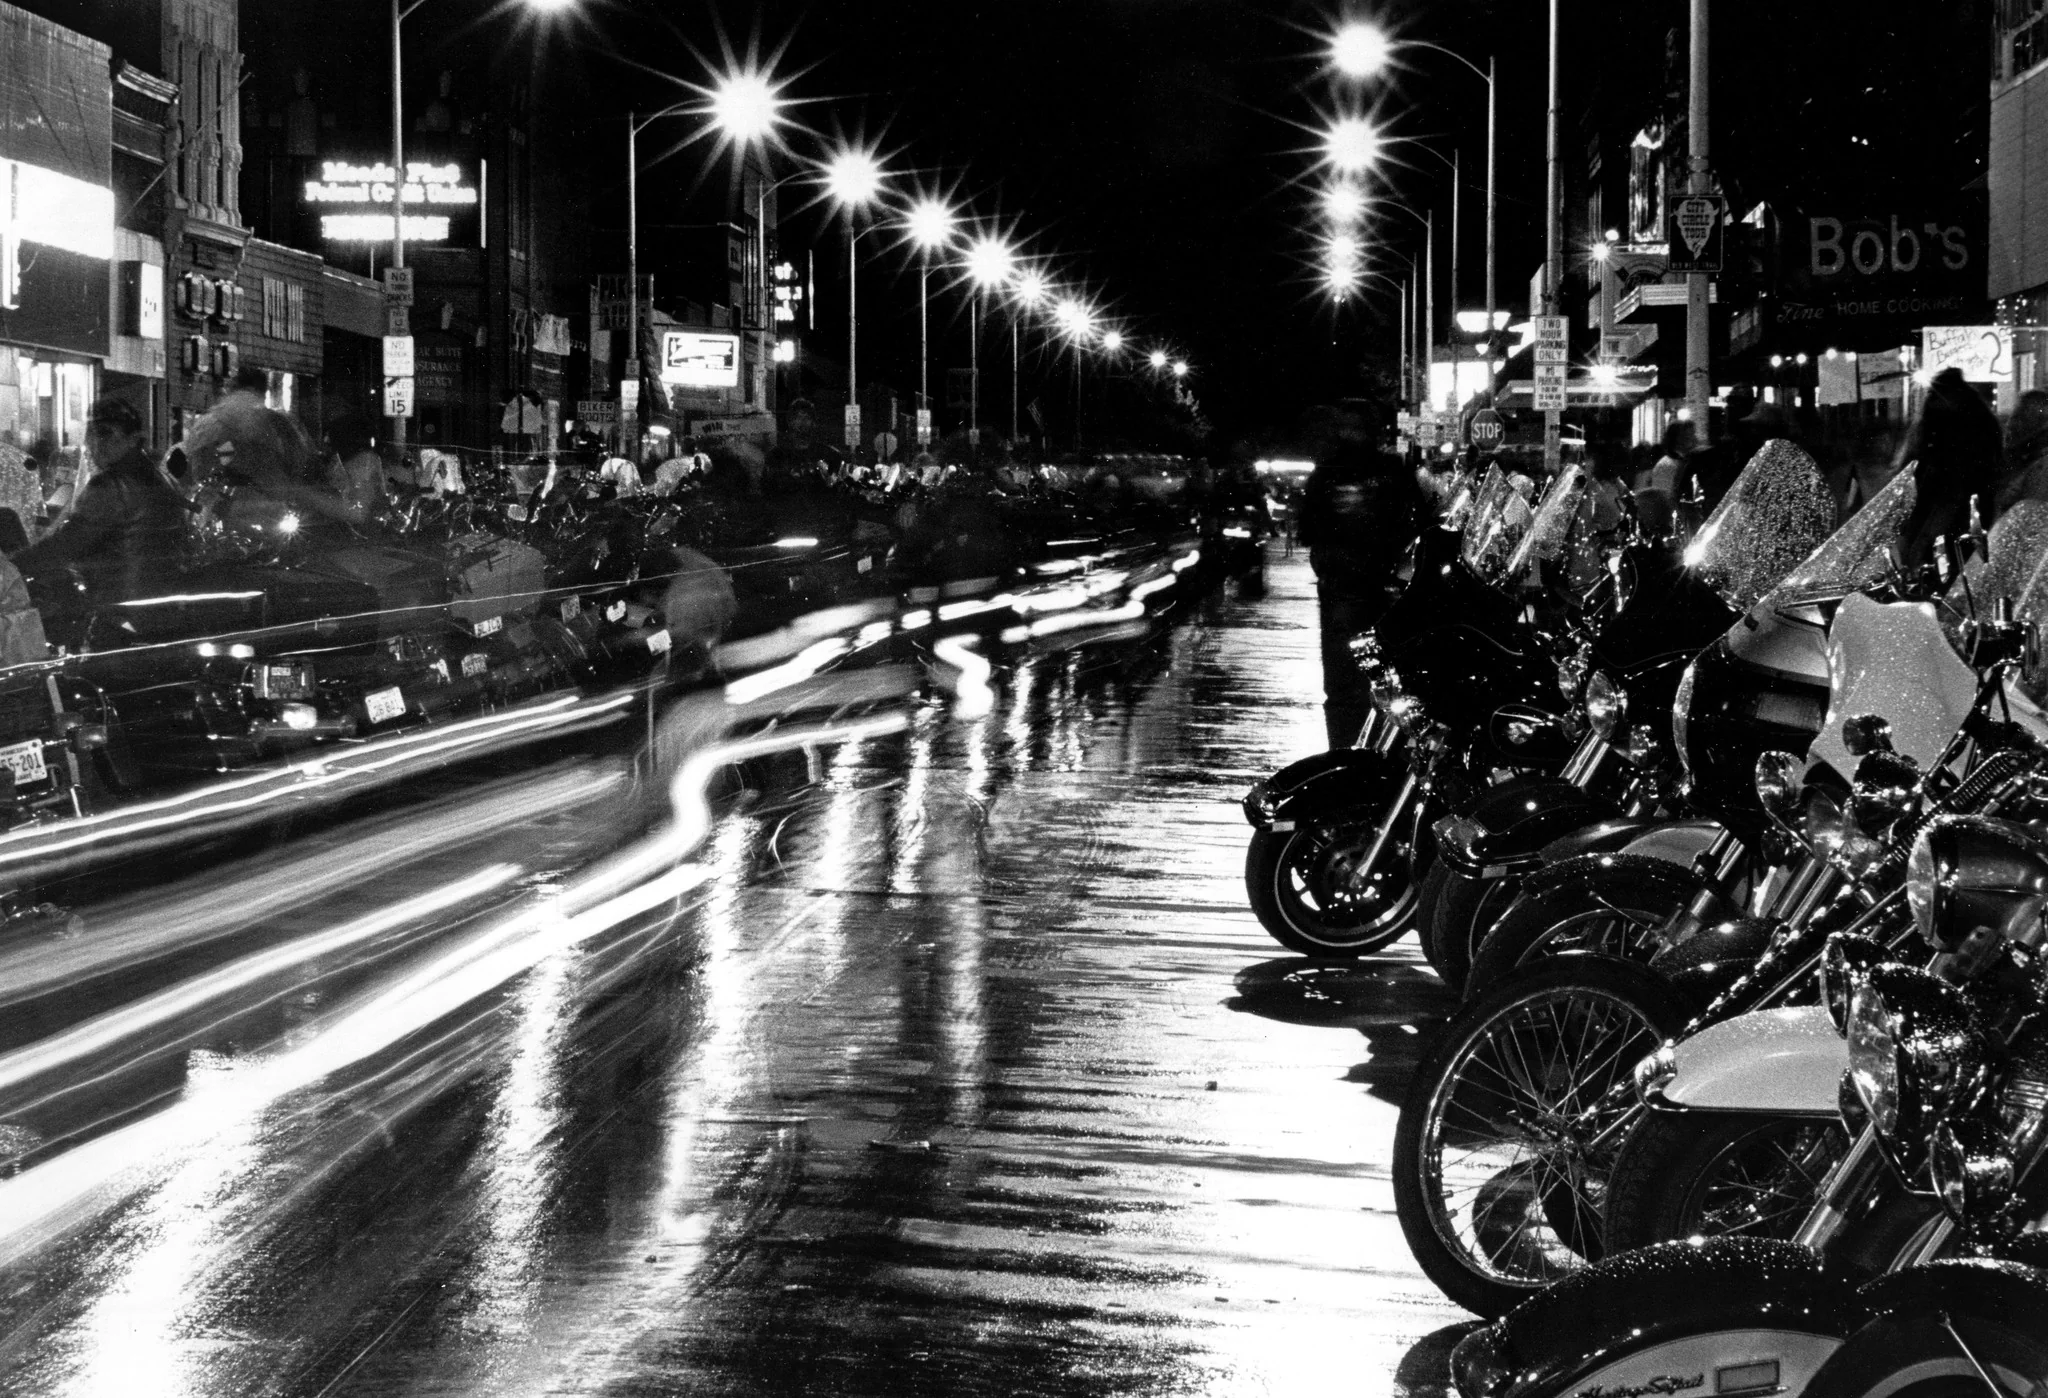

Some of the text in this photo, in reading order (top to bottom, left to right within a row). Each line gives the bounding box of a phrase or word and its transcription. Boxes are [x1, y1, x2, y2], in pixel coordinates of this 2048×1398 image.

[1687, 202, 1705, 212] CITY
[1682, 215, 1709, 225] CIRCLE
[1685, 228, 1706, 238] TOUR
[1810, 214, 1968, 275] Bob's
[391, 272, 406, 281] NO
[1543, 319, 1561, 329] TWO
[1540, 330, 1562, 340] HOUR
[1537, 340, 1566, 349] PARKING
[1539, 351, 1562, 360] ONLY
[391, 400, 406, 413] 15
[580, 402, 613, 411] BIKER
[1473, 423, 1502, 439] STOP
